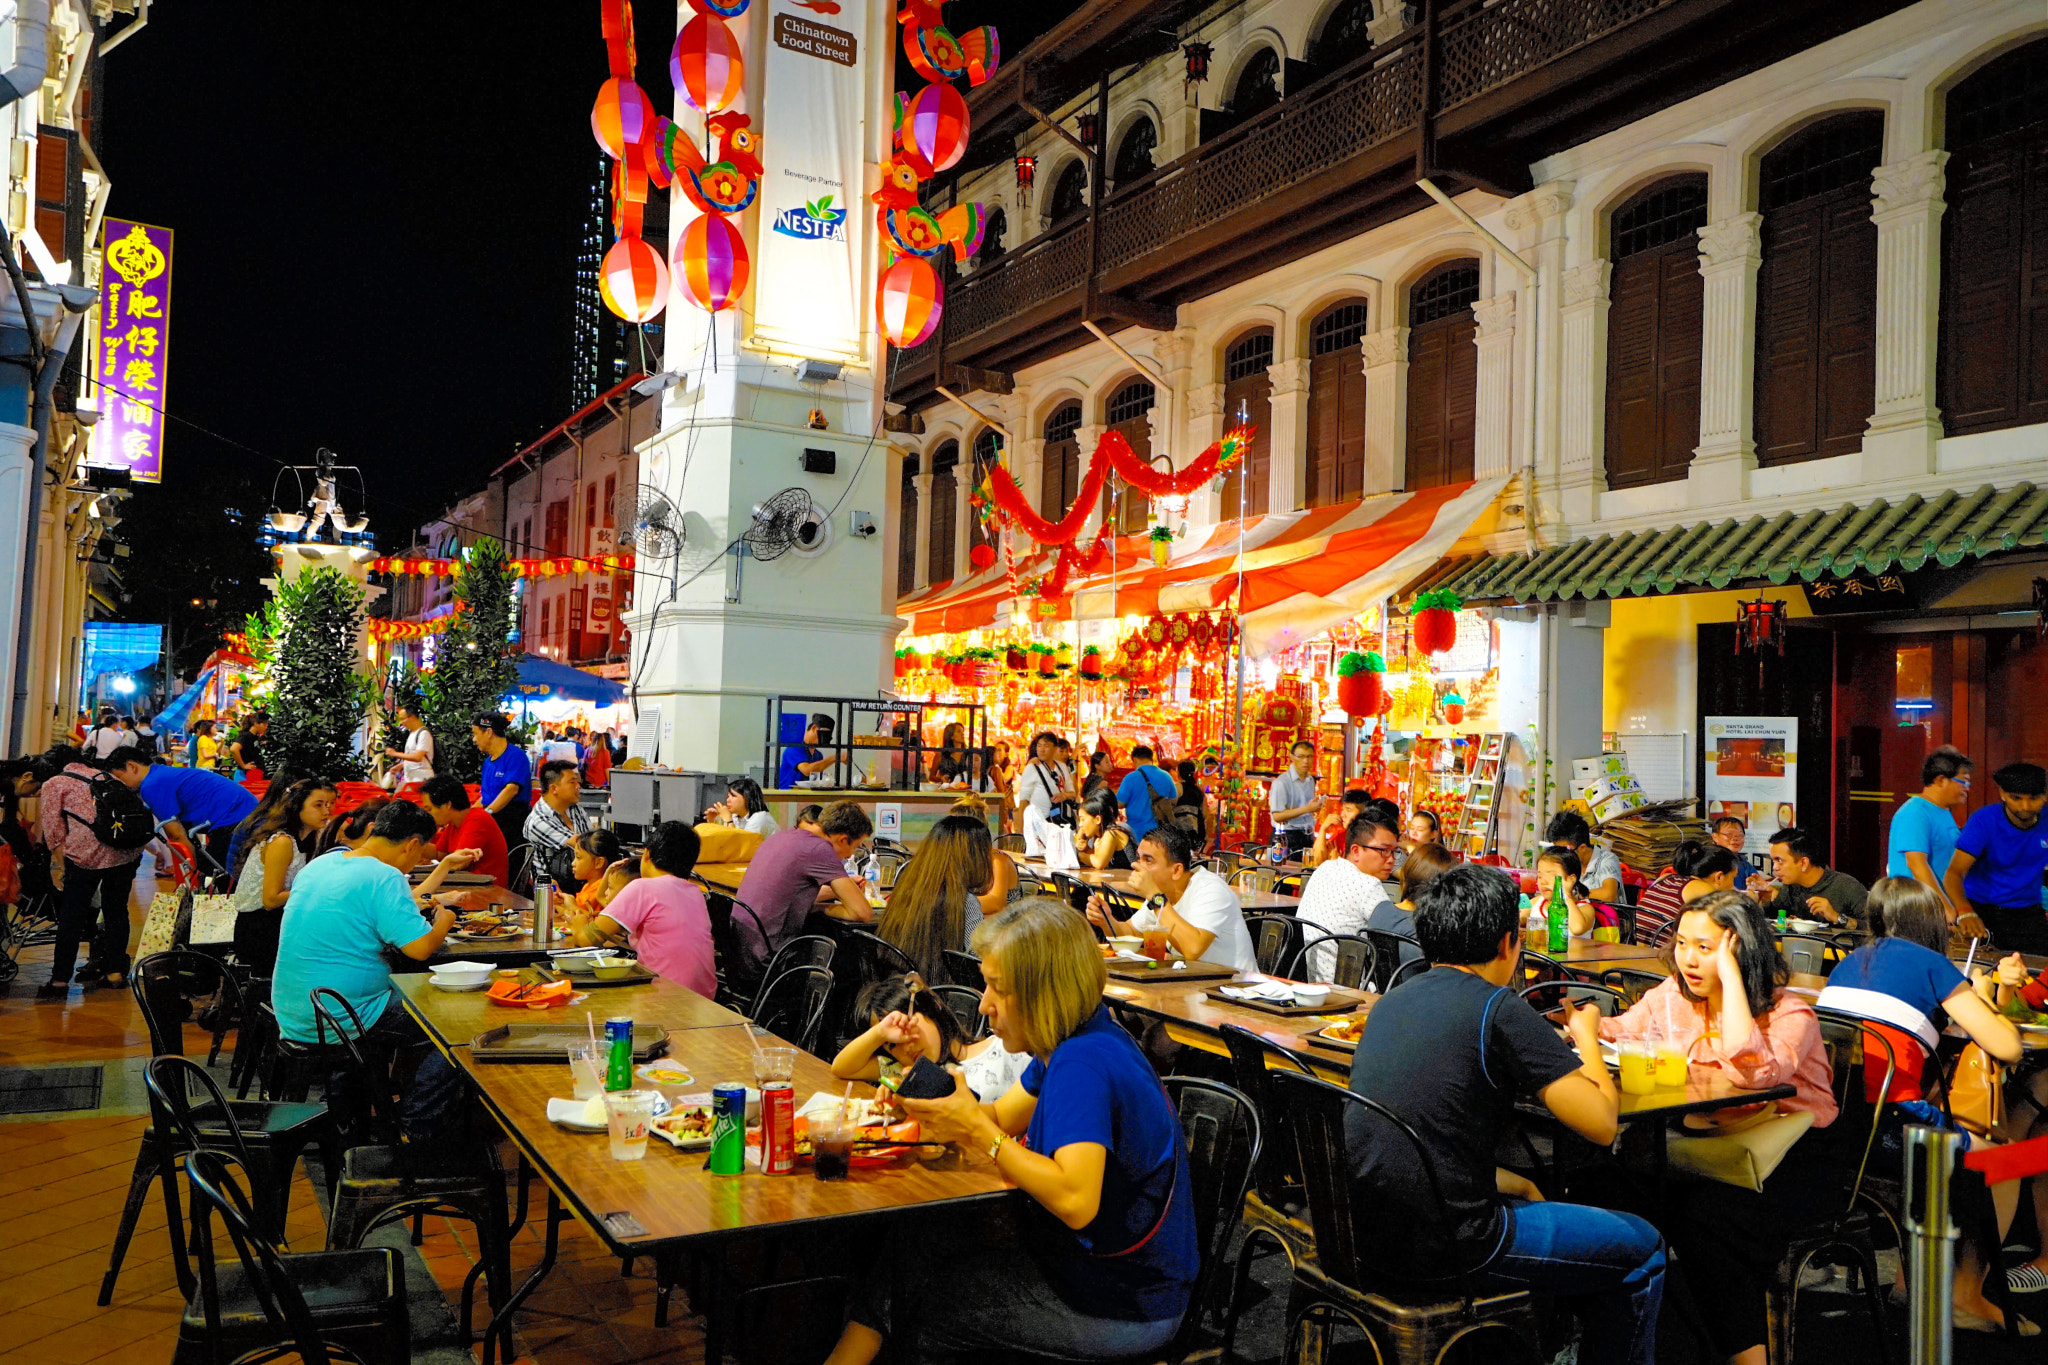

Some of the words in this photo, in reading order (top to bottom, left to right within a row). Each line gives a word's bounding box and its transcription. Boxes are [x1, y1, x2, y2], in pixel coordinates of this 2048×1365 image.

[783, 19, 850, 47] Chinatown
[782, 33, 813, 51] Food
[815, 42, 850, 62] Street
[784, 168, 817, 182] Beverage
[818, 176, 844, 188] Partner
[777, 207, 845, 242] NESTEA
[122, 289, 162, 461] 肥仔榮酒家
[519, 684, 538, 694] Tiger
[893, 704, 922, 712] COUNTER
